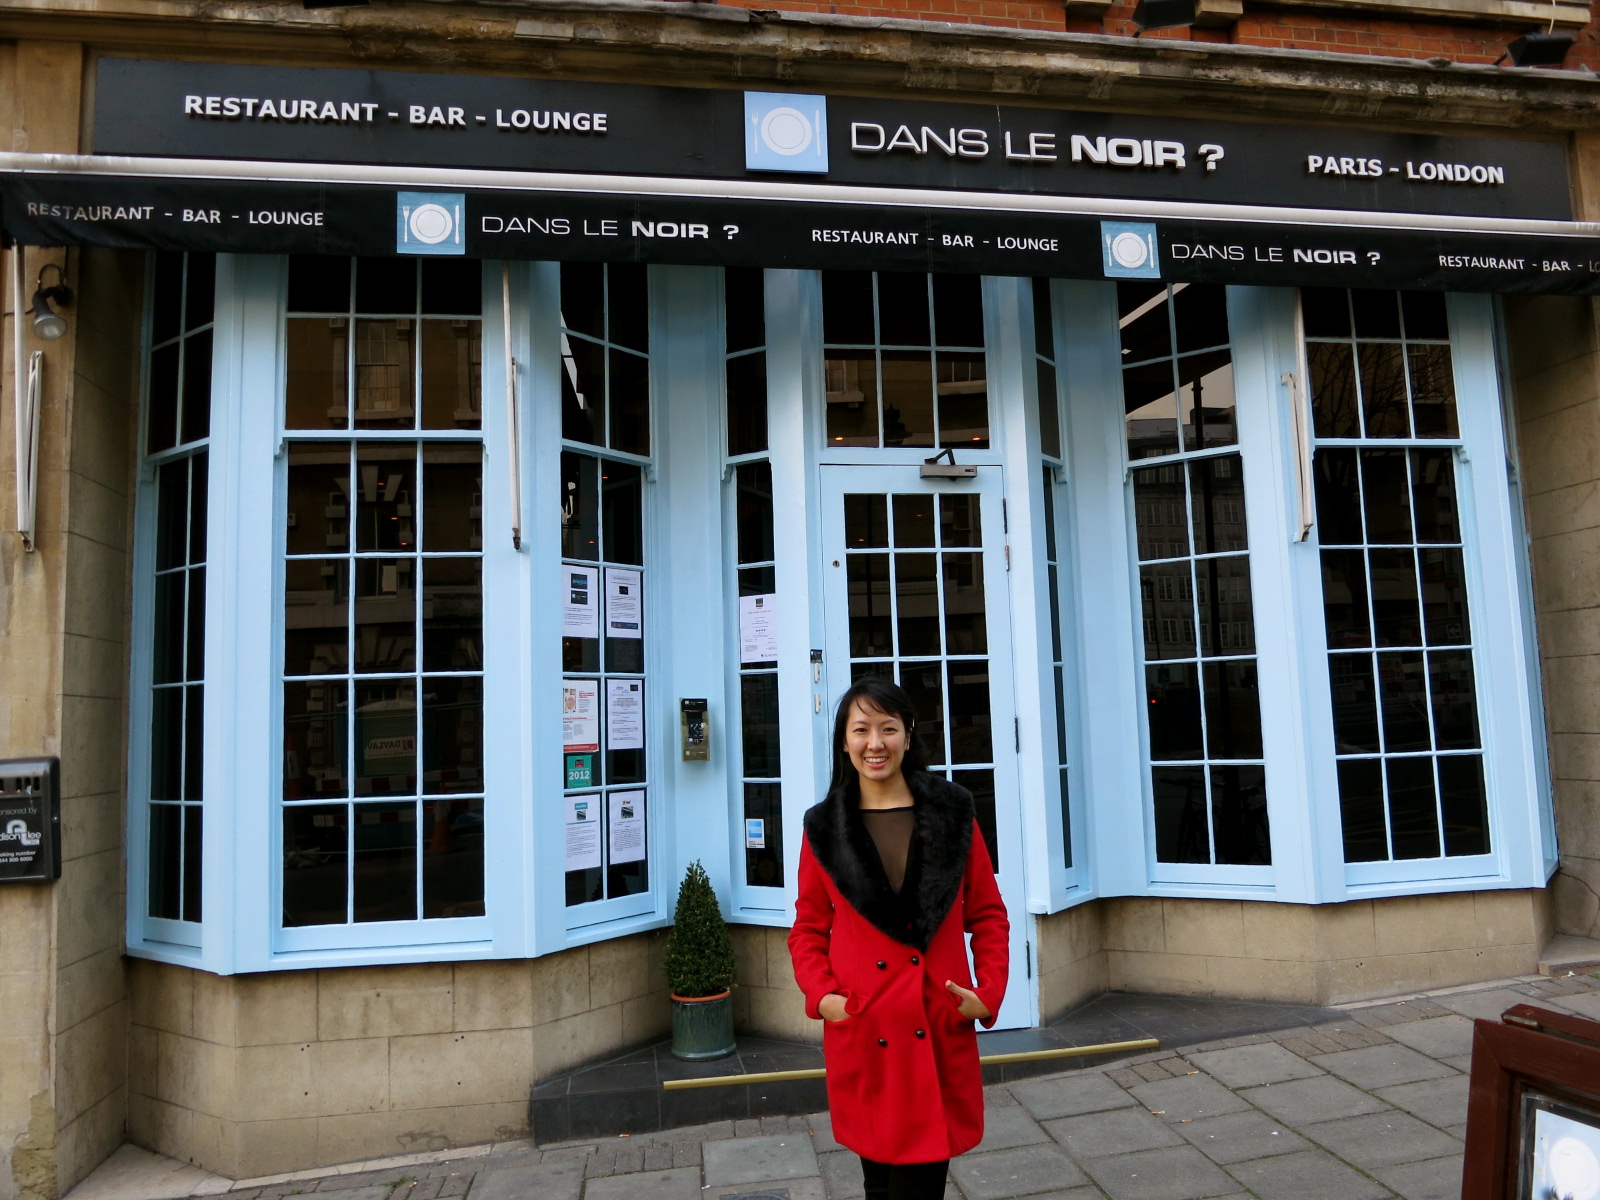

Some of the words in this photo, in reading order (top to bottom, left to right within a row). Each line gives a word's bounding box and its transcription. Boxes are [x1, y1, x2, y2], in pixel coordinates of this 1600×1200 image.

[185, 95, 378, 122] RESTAURANT
[409, 105, 467, 126] BAR
[496, 108, 608, 132] LOUNGE
[850, 121, 990, 157] DANS
[1004, 130, 1058, 162] LE
[1071, 134, 1186, 169] NOIR
[1198, 143, 1225, 172] ?
[1308, 154, 1383, 177] PARIS
[1406, 161, 1505, 184] LONDON
[27, 202, 154, 222] RESTAURANT
[182, 208, 222, 224] BAR
[248, 210, 325, 227] LOUNGE
[481, 216, 571, 236] DANS
[583, 219, 619, 237] LE
[631, 221, 709, 239] NOIR
[722, 224, 740, 240] ?
[811, 229, 919, 246] RESTAURANT
[942, 234, 975, 248] BAR
[997, 237, 1059, 252] LOUNGE
[1171, 243, 1245, 262] DANS
[1254, 246, 1284, 263] LE
[1293, 248, 1357, 265] NOIR
[1366, 251, 1381, 266] ?
[1438, 254, 1525, 271] RESTAURANT
[1542, 259, 1572, 272] BAR
[569, 770, 590, 781] 2012
[28, 807, 37, 816] by
[28, 831, 41, 839] lee
